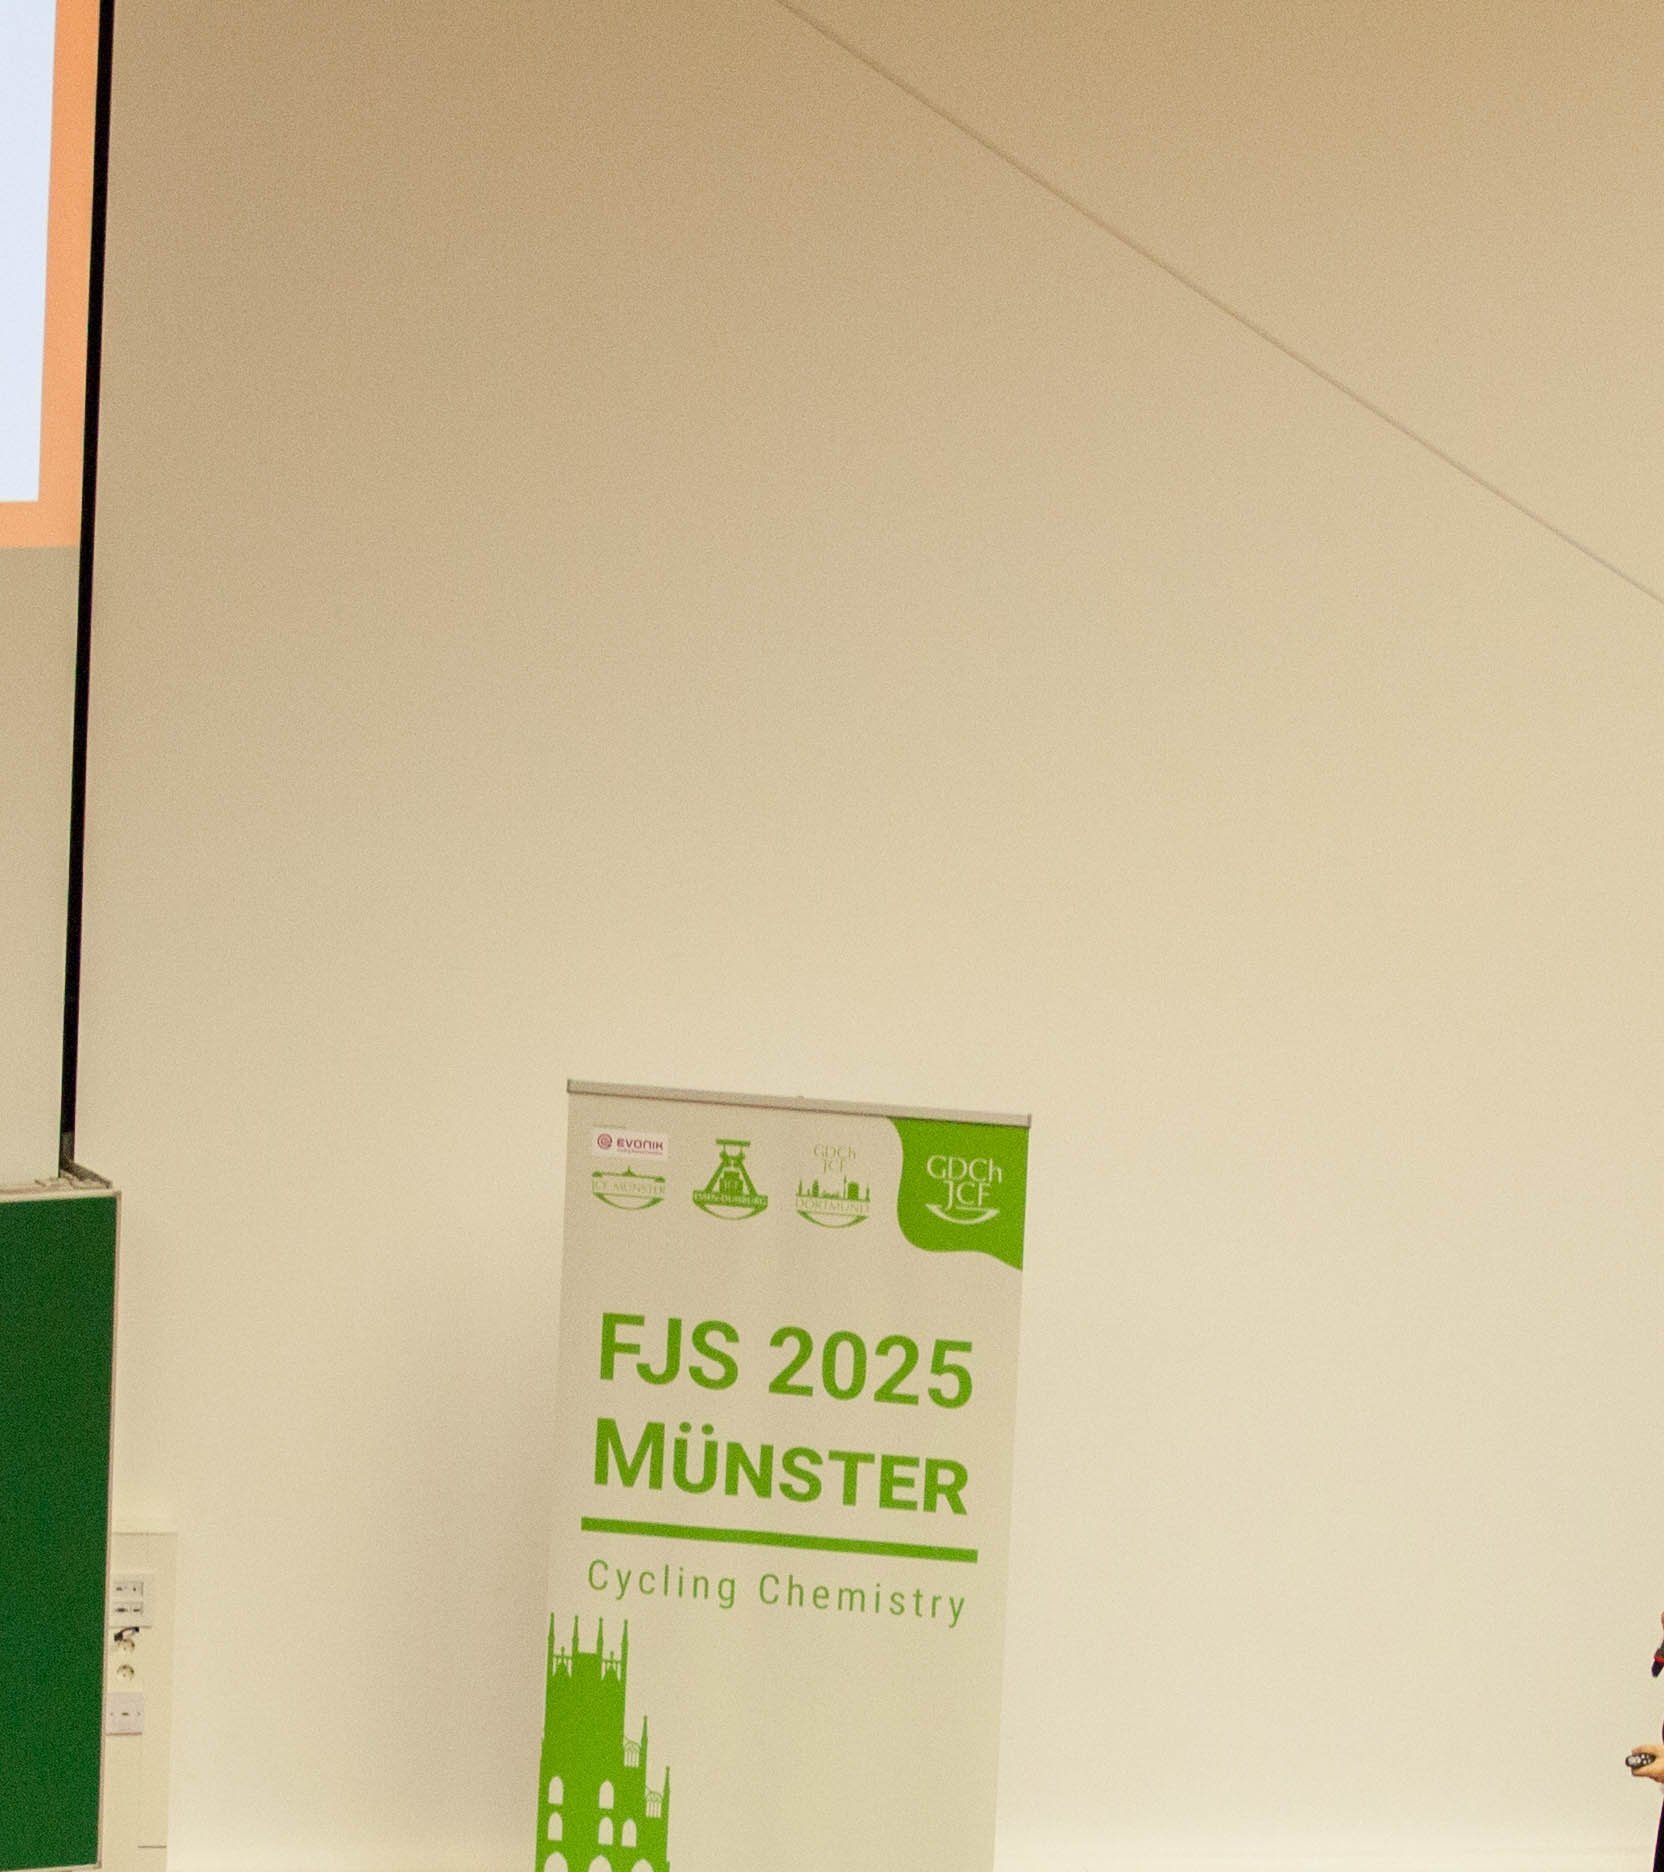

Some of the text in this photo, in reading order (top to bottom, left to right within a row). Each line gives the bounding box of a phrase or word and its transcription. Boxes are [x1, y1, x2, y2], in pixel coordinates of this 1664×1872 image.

[926, 1154, 1003, 1184] GDCh
[943, 1180, 993, 1211] JCF
[599, 1312, 974, 1409] FJS 2025
[593, 1417, 969, 1516] MÜNSTER
[587, 1559, 966, 1629] Cycling Chemistry
